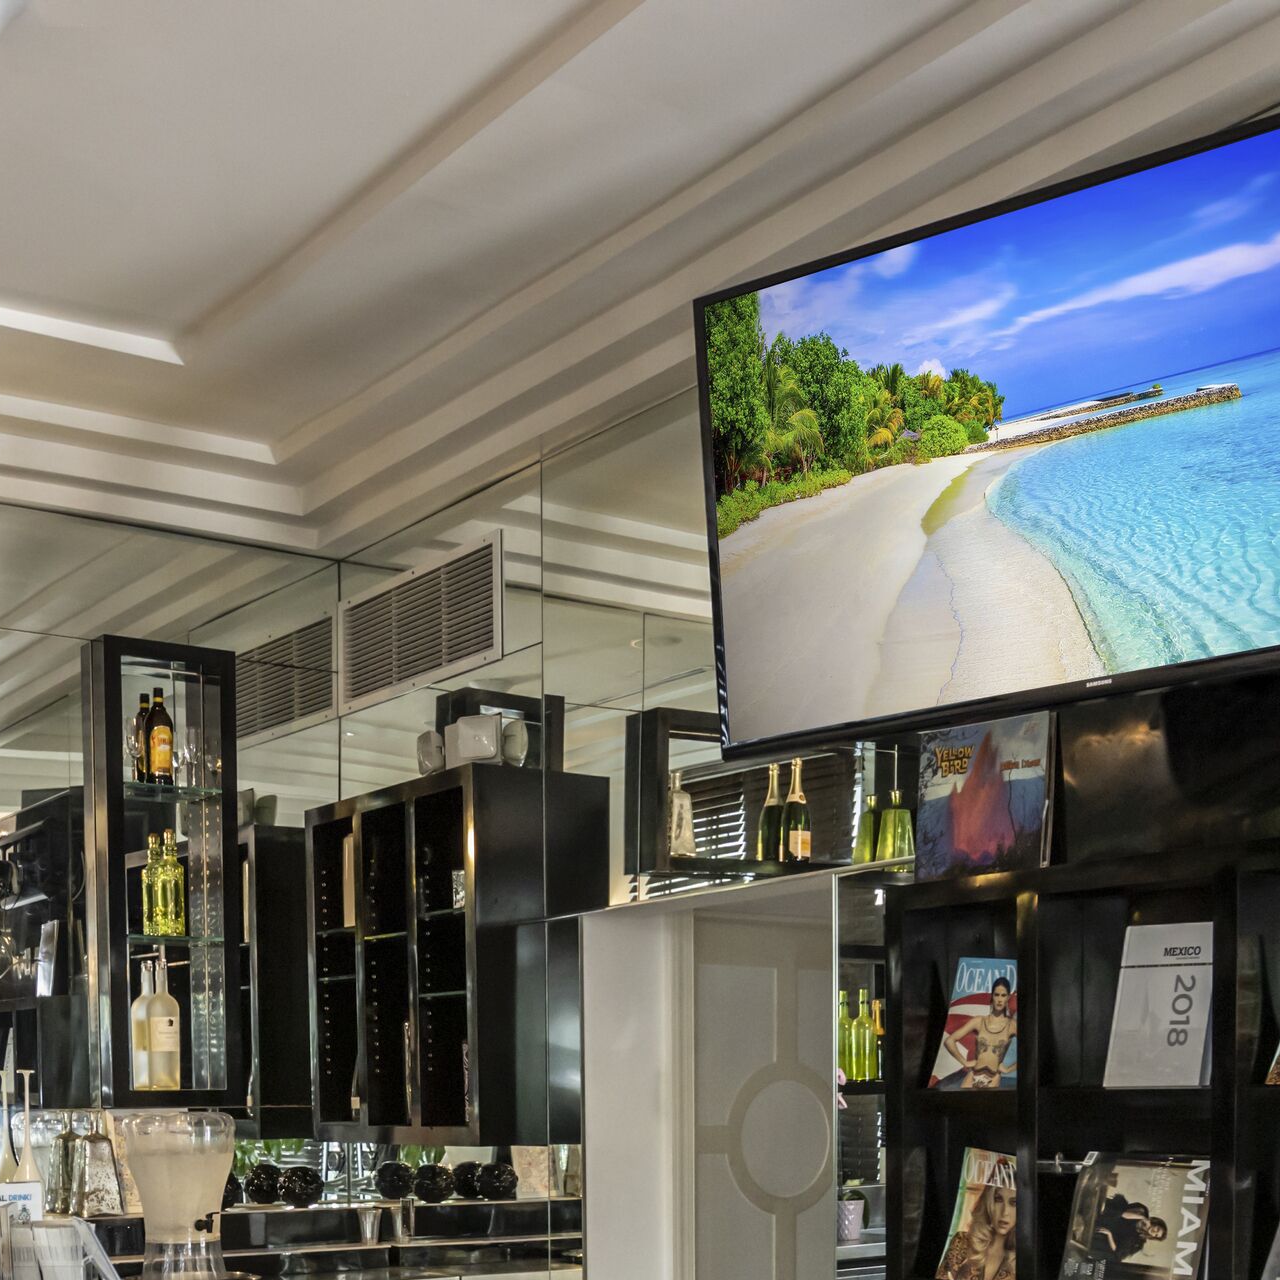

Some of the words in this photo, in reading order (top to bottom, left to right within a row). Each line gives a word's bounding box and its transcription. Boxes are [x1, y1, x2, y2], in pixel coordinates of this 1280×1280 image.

[1086, 678, 1113, 688] SAMSUNG
[935, 744, 975, 768] YELLOW
[1163, 946, 1202, 957] MEXICO
[1167, 974, 1197, 1047] 2018
[8, 1193, 32, 1202] DRINK!
